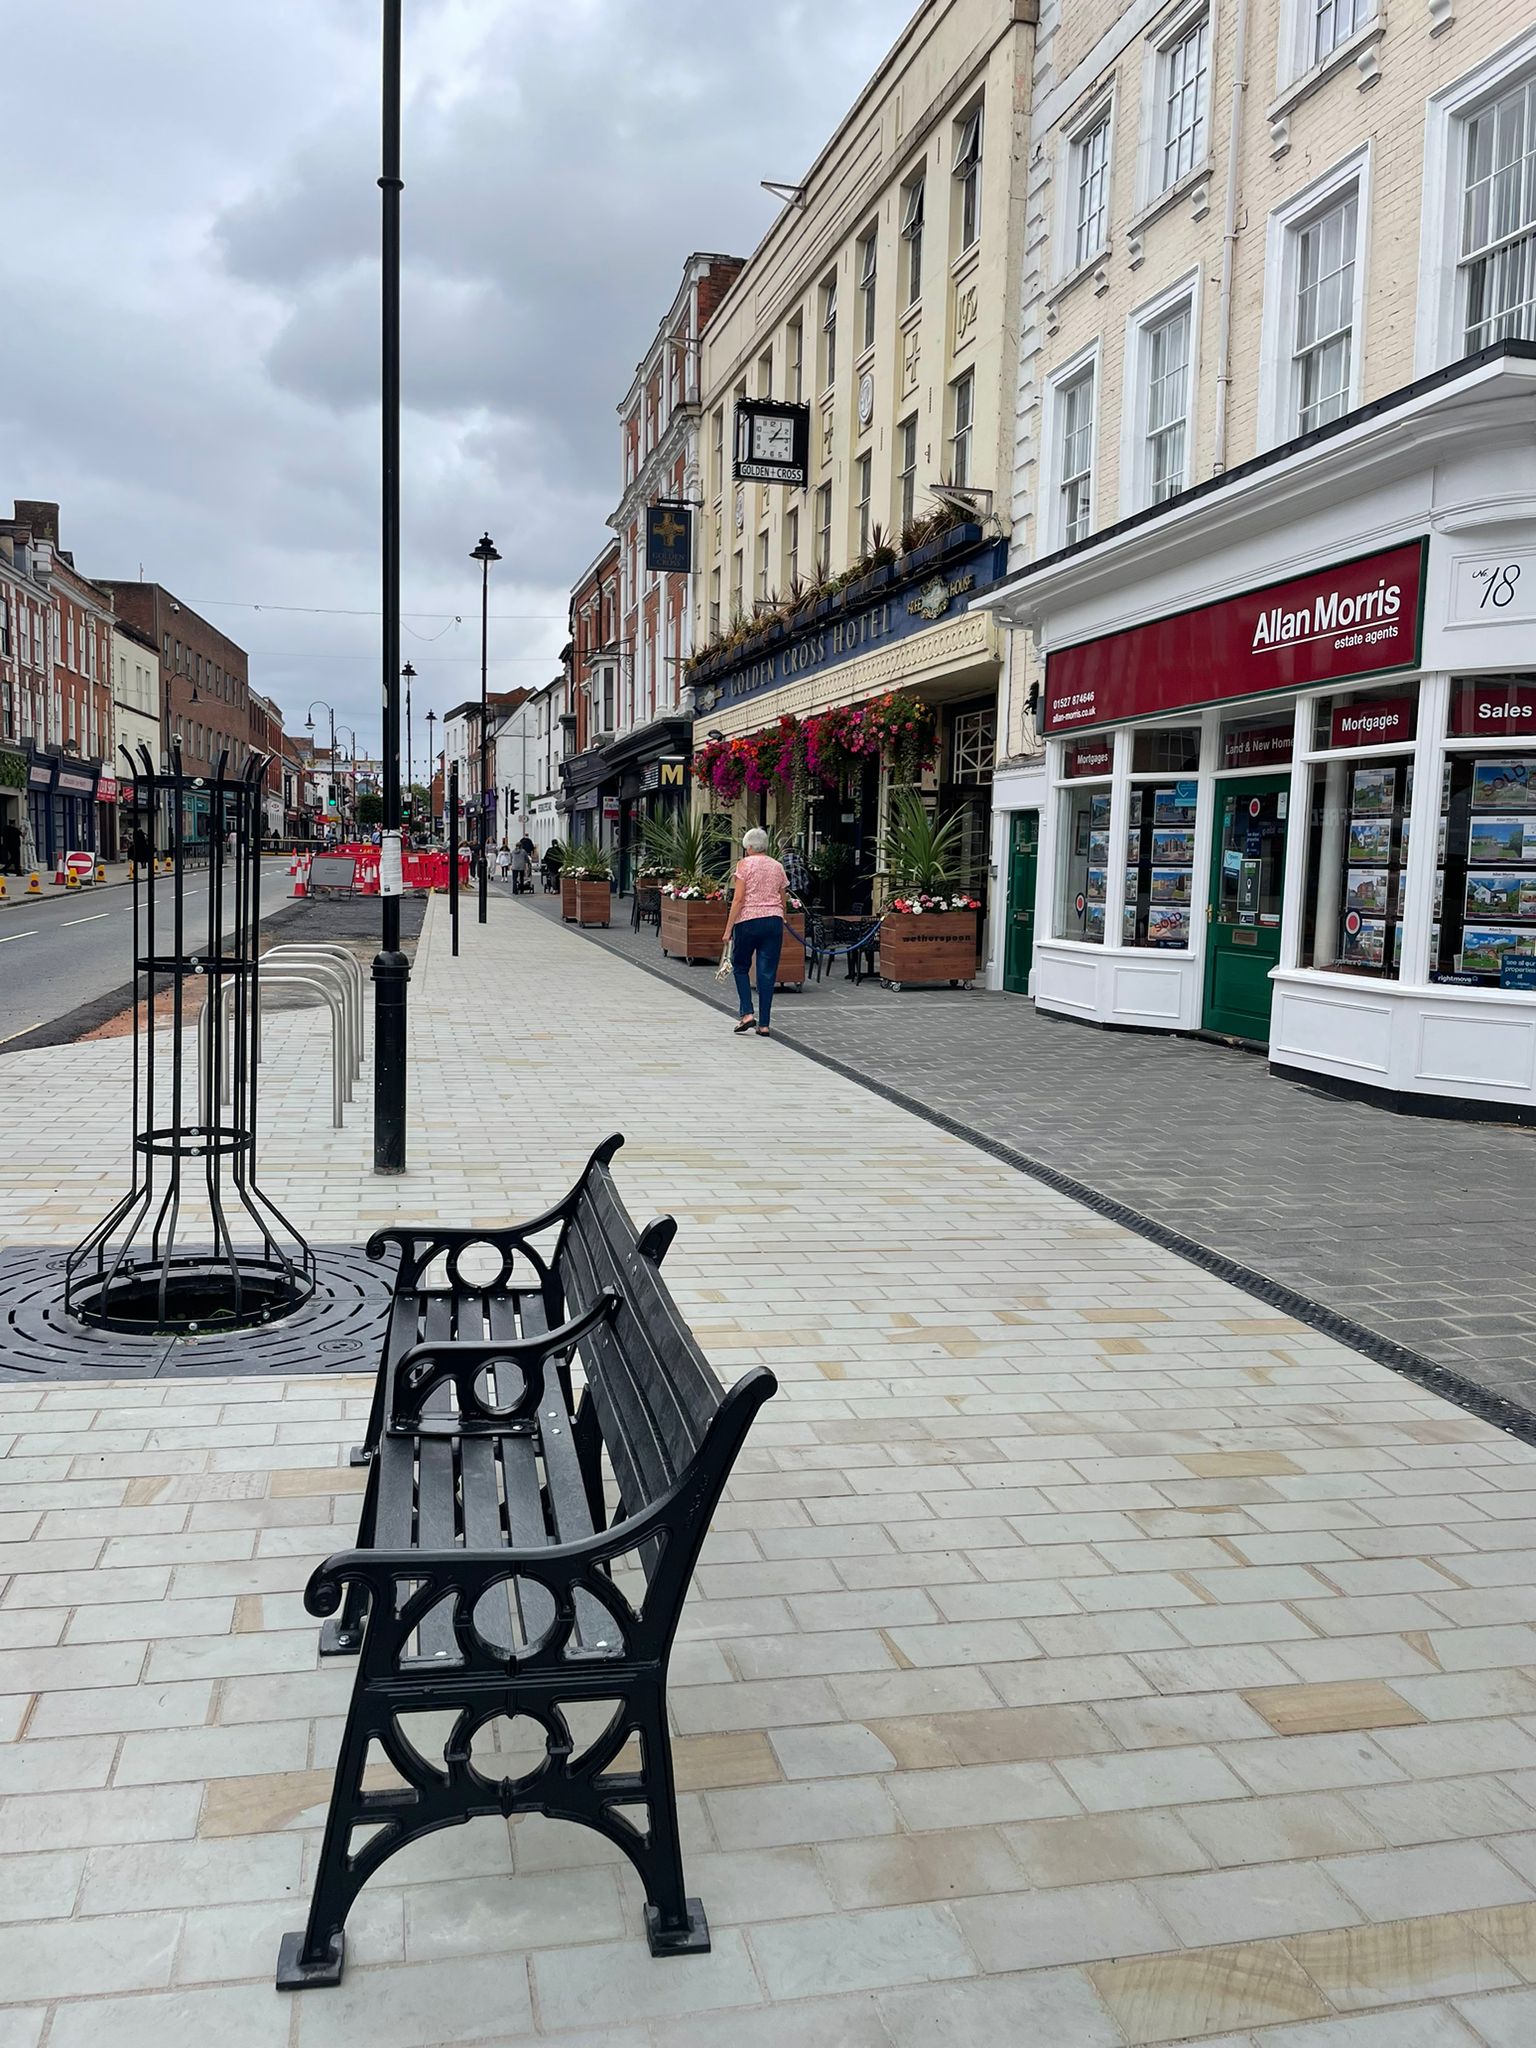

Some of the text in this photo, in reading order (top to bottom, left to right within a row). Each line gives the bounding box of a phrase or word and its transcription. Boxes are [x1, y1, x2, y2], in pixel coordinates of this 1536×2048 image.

[741, 465, 802, 480] GOLDEN CROSS
[1480, 564, 1521, 608] 18
[1252, 579, 1401, 647] Allan Morris
[1334, 625, 1399, 649] estate agents
[730, 604, 889, 696] GOLDEN CROSS HOTEL
[1053, 696, 1071, 709] 01527
[1478, 702, 1533, 719] Sales
[1052, 705, 1096, 723] allan-morris.co.uk
[1341, 714, 1399, 732] Mortgages
[1225, 742, 1244, 755] Land
[1244, 741, 1251, 752] &
[1252, 740, 1271, 751] New
[1077, 753, 1108, 765] Mortgages
[661, 764, 684, 785] M
[1483, 764, 1526, 797] SOLD
[1154, 911, 1182, 933] SOLD
[902, 934, 971, 944] wetherspoon
[1437, 975, 1472, 983] rightmove
